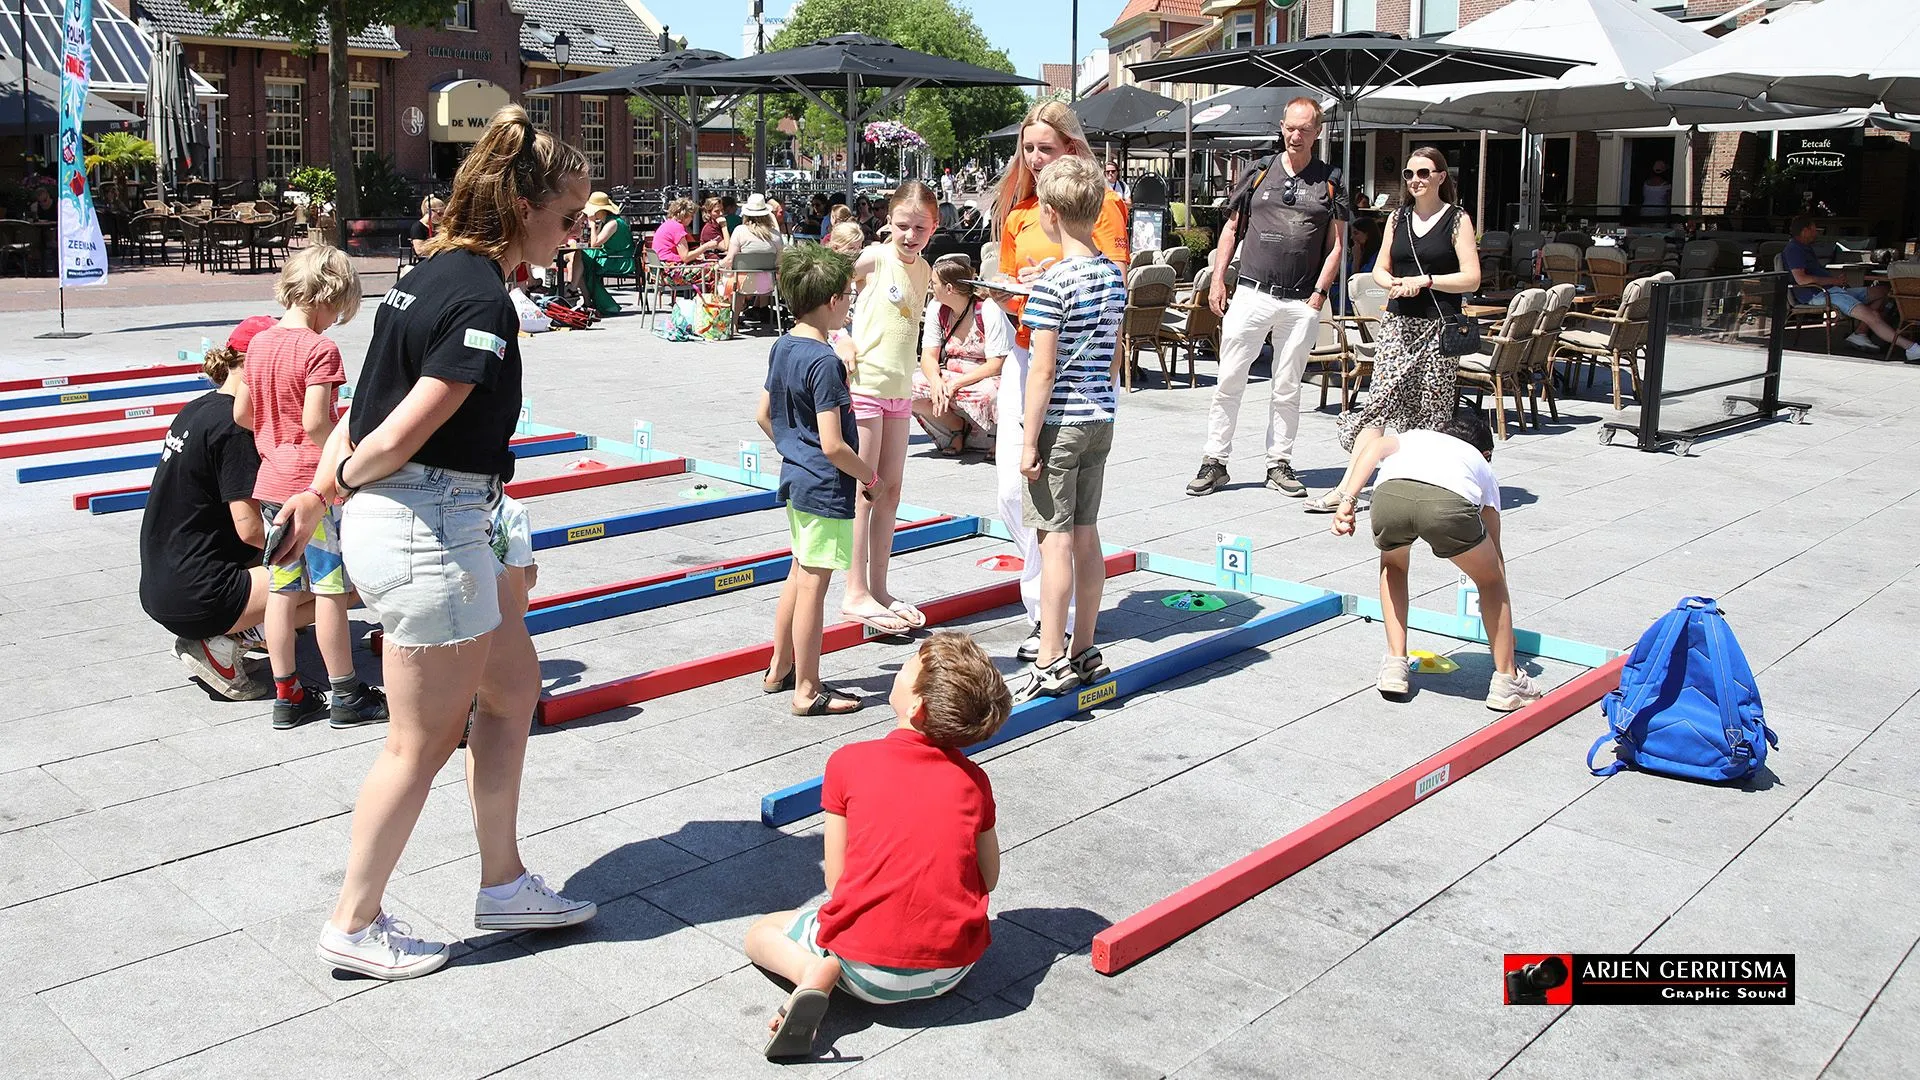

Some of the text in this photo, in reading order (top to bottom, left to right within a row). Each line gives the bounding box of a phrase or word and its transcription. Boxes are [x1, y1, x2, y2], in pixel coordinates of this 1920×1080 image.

[451, 119, 464, 128] DE
[1801, 138, 1831, 148] Eetcafé
[1787, 157, 1843, 167] Old Niekark
[62, 394, 87, 402] ZEEMAN
[128, 408, 151, 417] univé
[639, 435, 645, 445] 6
[746, 457, 752, 468] 5
[570, 526, 603, 539] ZEEMAN
[1229, 553, 1239, 568] 2
[717, 572, 751, 587] ZEEMAN
[1081, 685, 1115, 705] ZEEMAN
[1419, 765, 1446, 794] univé
